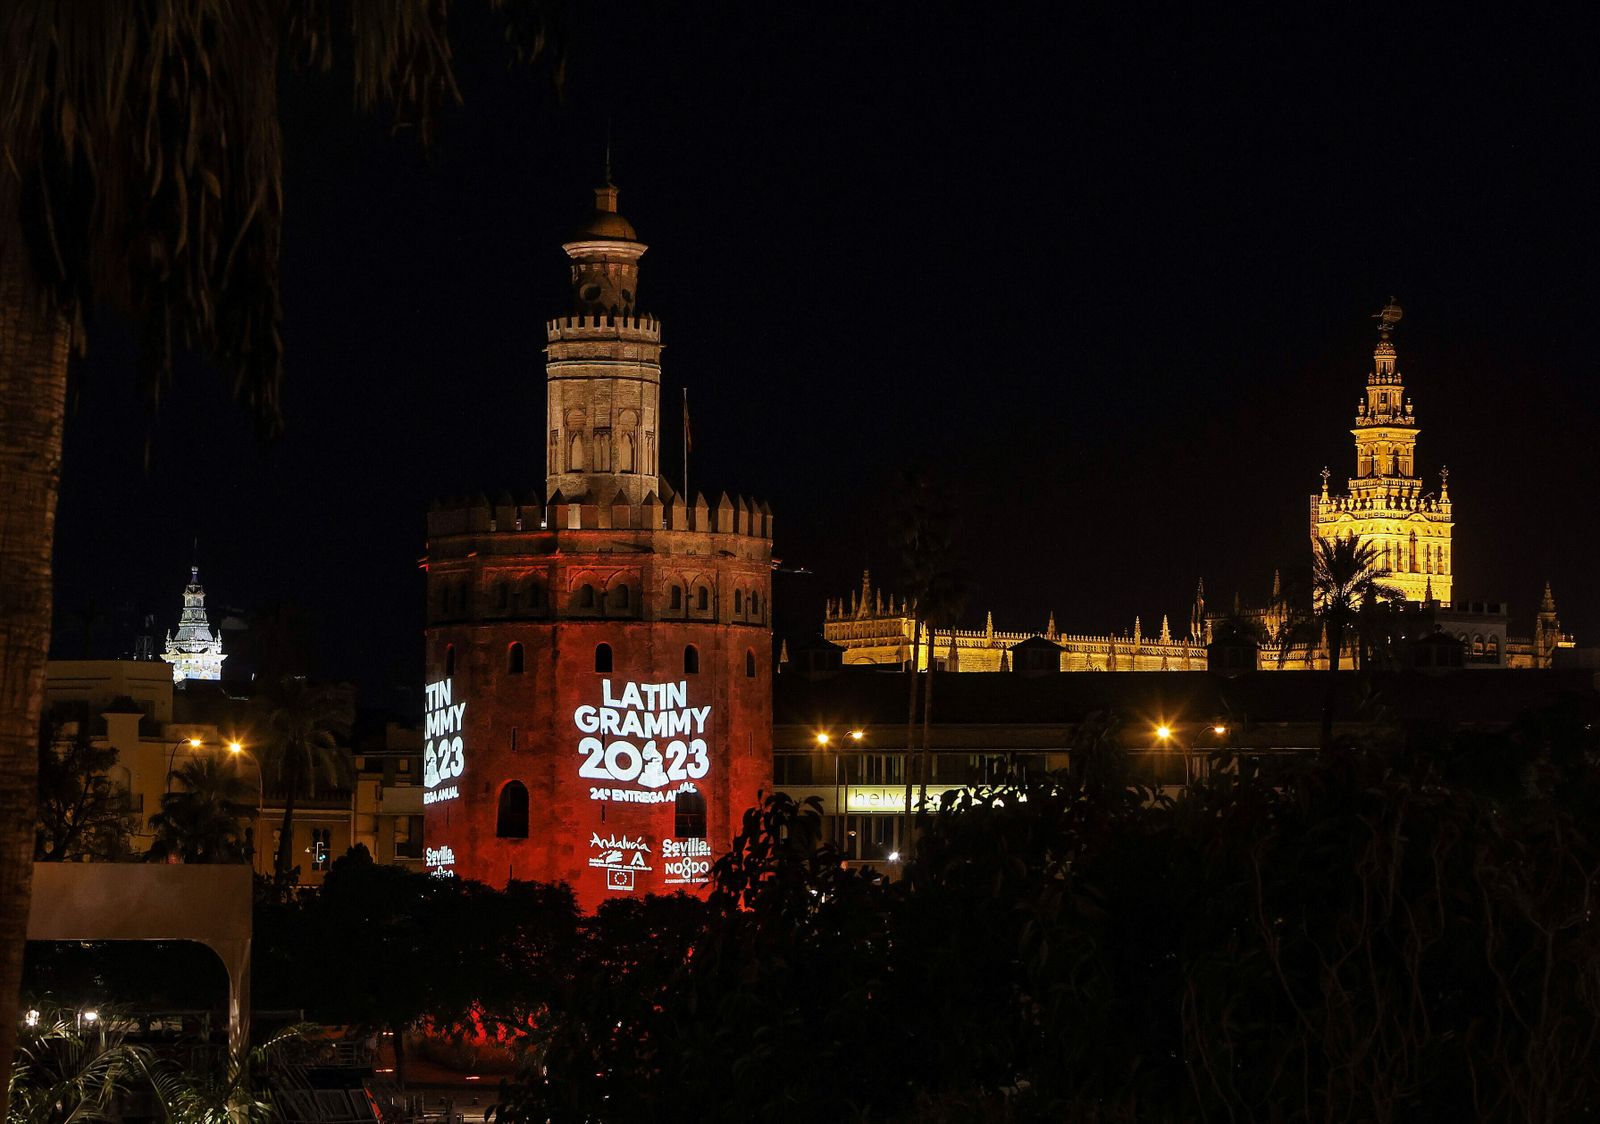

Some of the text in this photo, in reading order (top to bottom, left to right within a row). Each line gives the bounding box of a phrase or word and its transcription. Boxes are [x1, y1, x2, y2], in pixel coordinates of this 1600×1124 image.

[424, 678, 451, 712] TIN
[602, 679, 687, 711] LATIN
[424, 702, 466, 740] MMY
[574, 705, 712, 739] GRAMMY
[611, 789, 664, 803] ENTREGA
[589, 831, 652, 853] Andalucía
